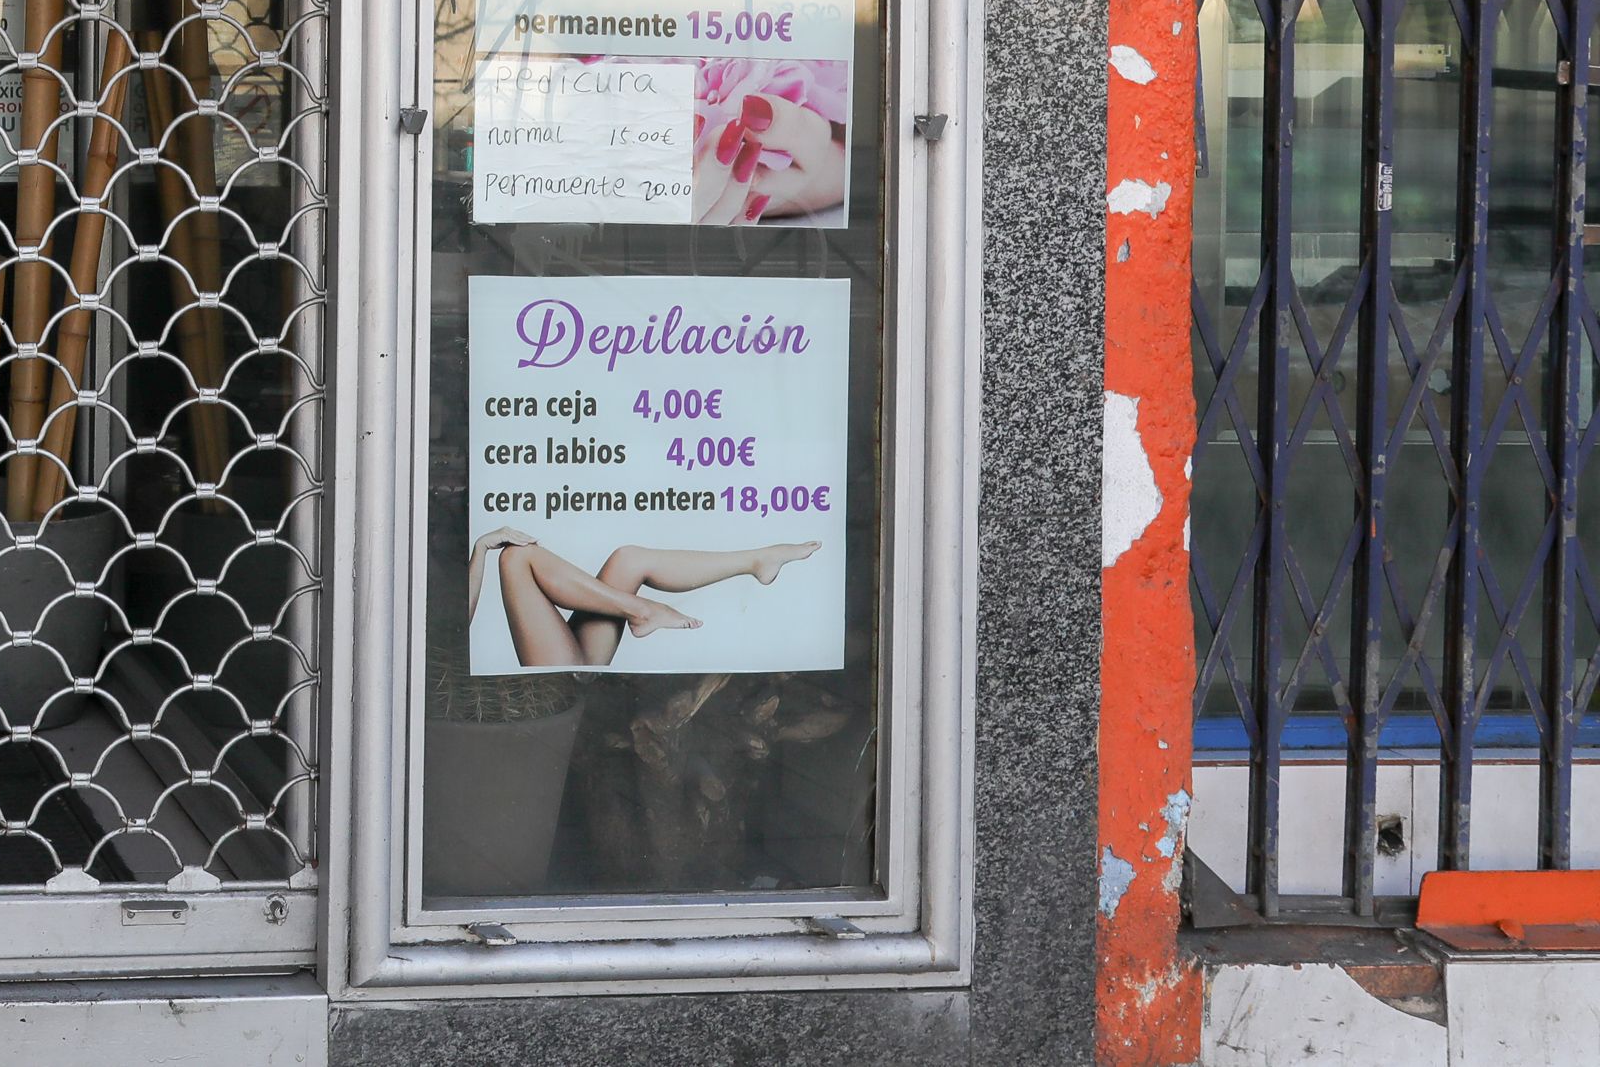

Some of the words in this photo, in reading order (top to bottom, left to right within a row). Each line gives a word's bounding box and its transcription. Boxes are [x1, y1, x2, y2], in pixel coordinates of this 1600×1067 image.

[515, 13, 677, 41] permanente
[687, 11, 793, 45] 15,00€
[487, 125, 564, 146] normal
[515, 299, 811, 372] Depilación
[485, 397, 537, 417] cera
[546, 390, 597, 424] ceja
[633, 389, 723, 423] 4,00€
[484, 444, 537, 464] cera
[546, 438, 626, 465] labios
[666, 437, 756, 471] 4,00€
[483, 492, 536, 512] cera
[545, 485, 627, 519] pierna
[634, 487, 715, 512] entera
[720, 486, 831, 518] 18,00€
